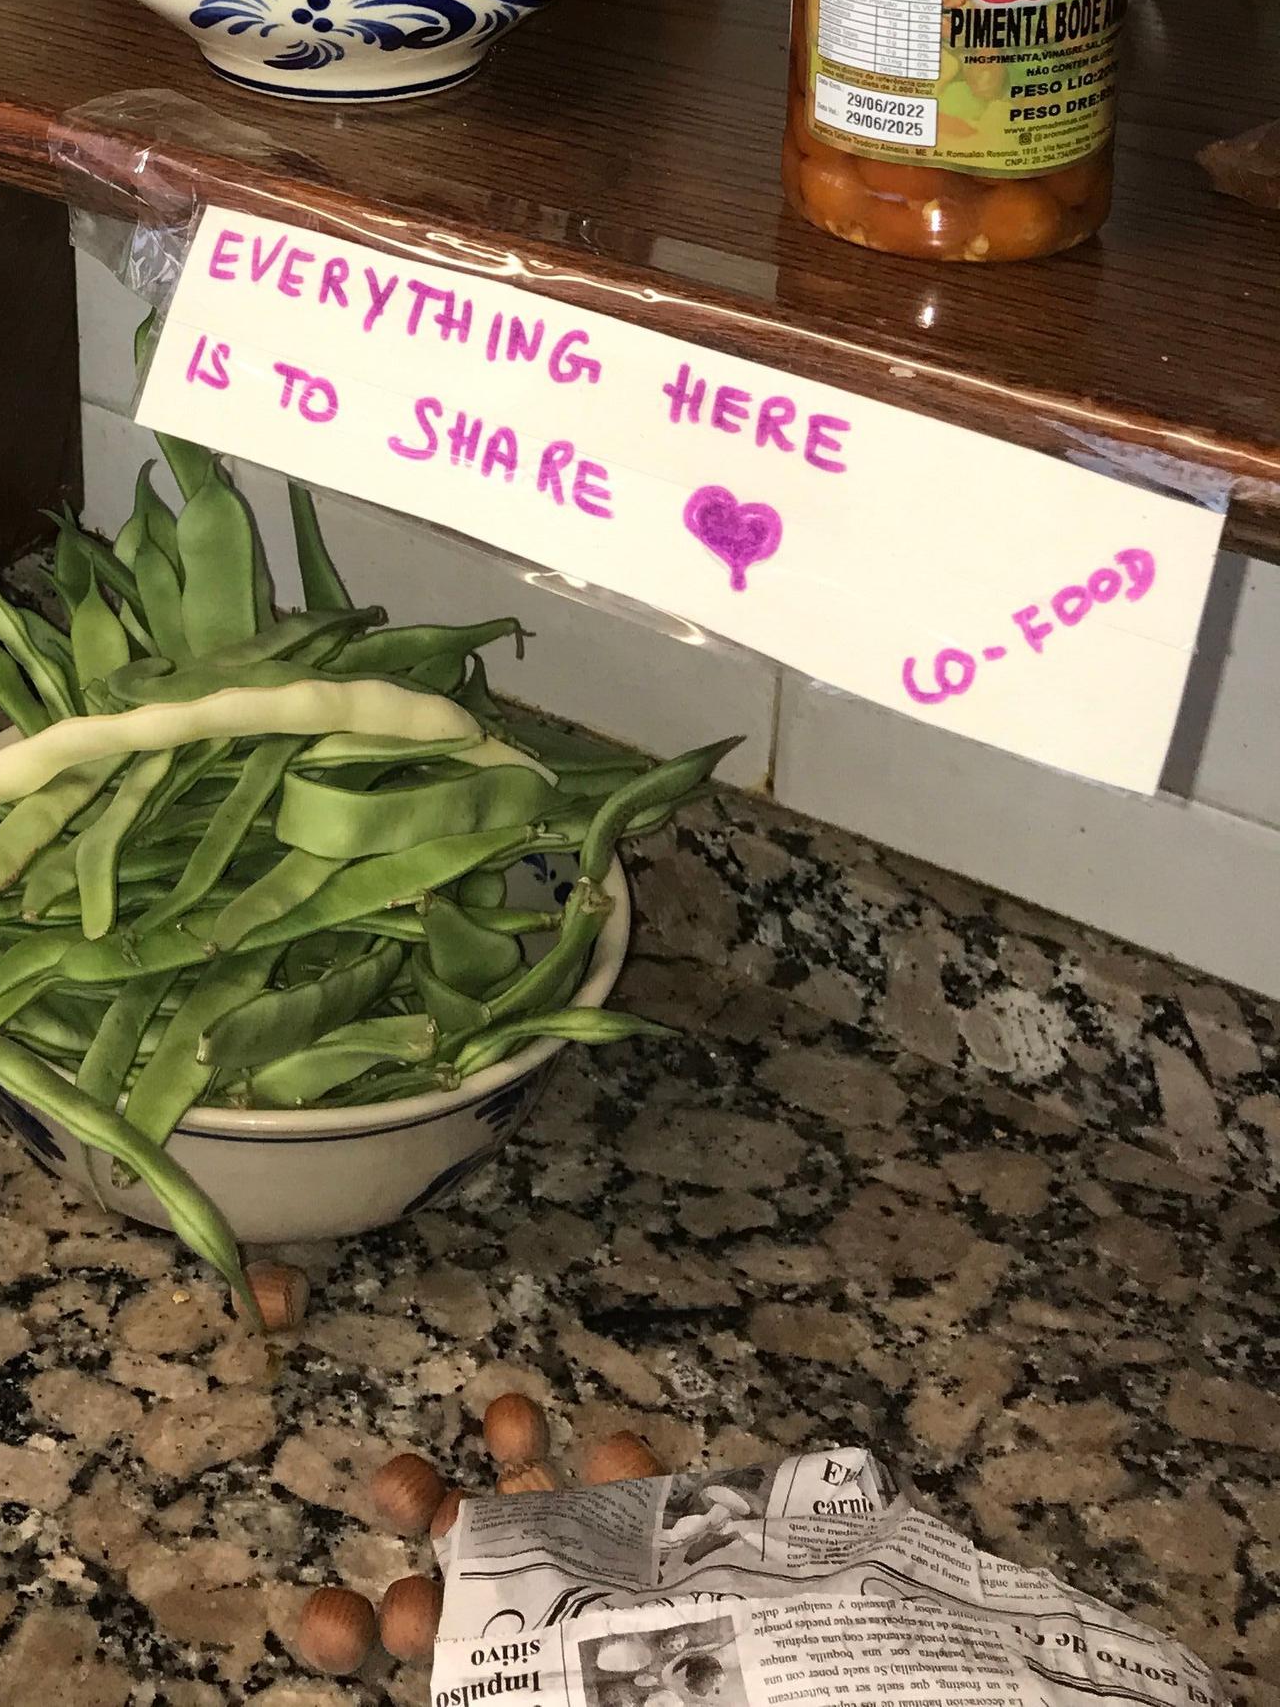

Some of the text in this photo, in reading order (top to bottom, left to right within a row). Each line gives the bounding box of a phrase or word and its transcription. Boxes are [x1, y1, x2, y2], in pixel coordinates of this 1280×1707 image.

[949, 5, 1049, 49] PIMENTA
[1026, 65, 1050, 77] NÃO
[1010, 80, 1062, 98] PESO
[847, 91, 925, 119] 29/06/2022
[1009, 103, 1061, 122] PESO
[845, 109, 923, 137] 29/06/2025
[208, 227, 854, 475] EVERYTHING HERE
[186, 335, 615, 521] IS TO SHARE
[910, 1553, 929, 1568] con
[750, 1607, 780, 1621] dulce
[783, 1600, 833, 1615] cualquier
[794, 1616, 832, 1630] puedes
[833, 1616, 850, 1626] que
[854, 1617, 867, 1626] es
[868, 1615, 917, 1627] cupcakes
[919, 1619, 936, 1631] los
[936, 1620, 949, 1631] de
[753, 1622, 793, 1638] ponerle
[772, 1633, 946, 1649] puede extender con una espátula.
[470, 1638, 541, 1667] sitivo
[806, 1650, 855, 1663] boquilla,
[861, 1648, 883, 1657] una
[890, 1648, 910, 1656] con
[1054, 1632, 1179, 1687] gorro de
[759, 1654, 798, 1667] aunque
[763, 1665, 975, 1686] de suele poner con una
[435, 1670, 542, 1707] Impulso
[767, 1678, 1020, 1705] de un frosting, que suele ser un buttercream
